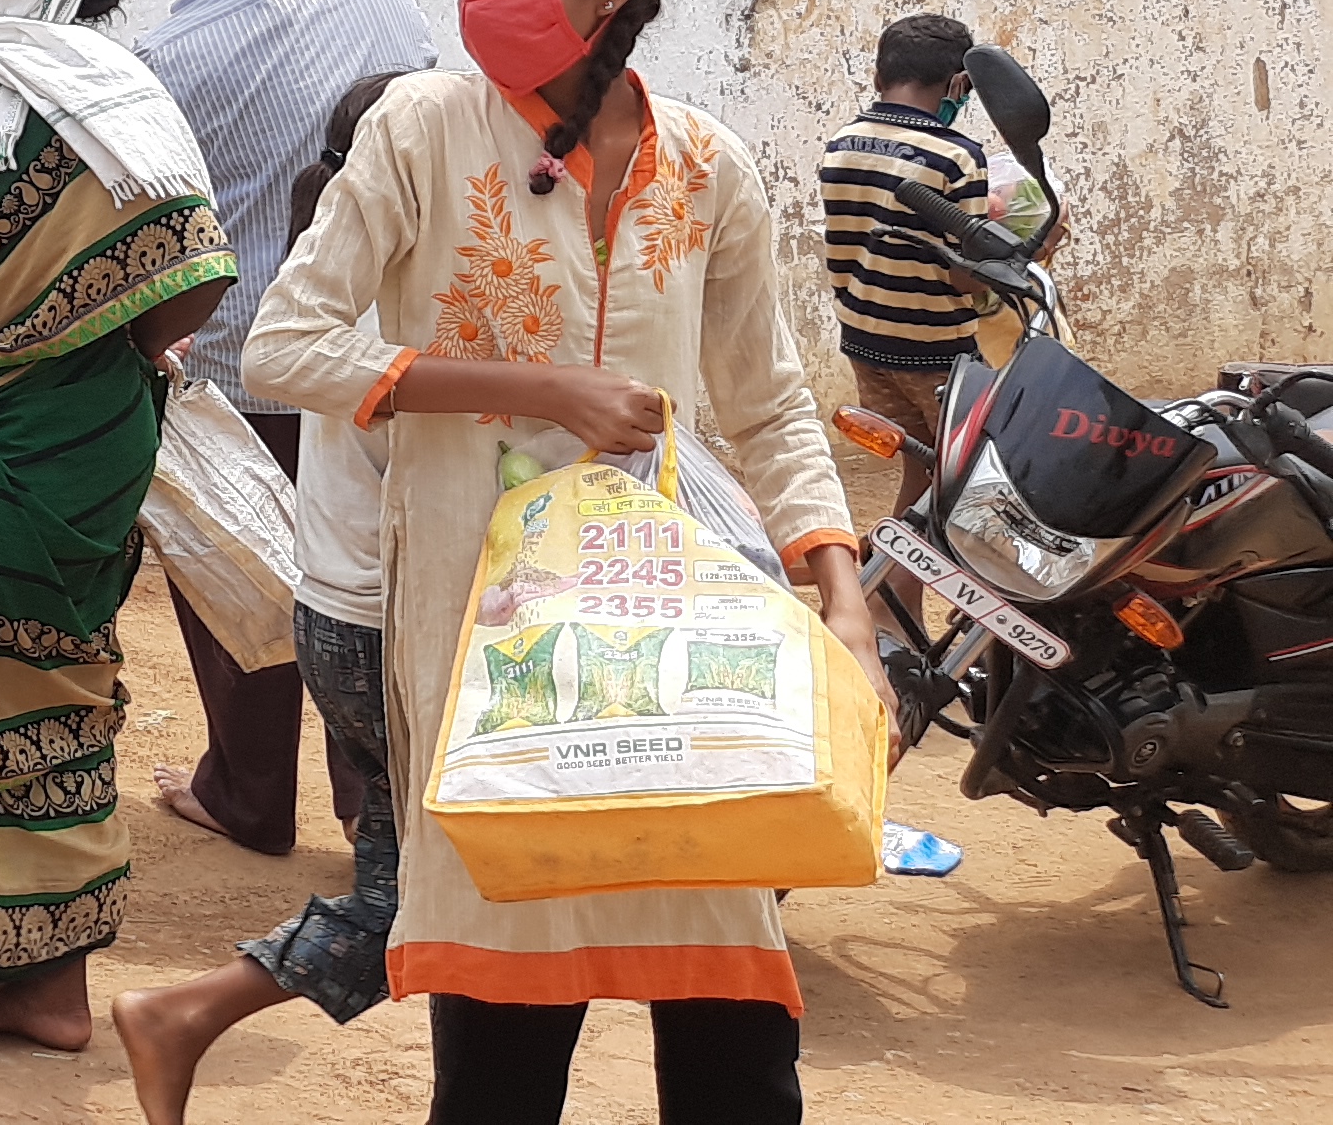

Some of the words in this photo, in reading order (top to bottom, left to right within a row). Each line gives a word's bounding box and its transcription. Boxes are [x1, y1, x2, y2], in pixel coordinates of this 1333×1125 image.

[1049, 408, 1176, 458] Divya
[580, 520, 681, 551] 2111
[580, 558, 684, 587] 2245
[579, 595, 683, 618] 2355
[957, 582, 984, 605] W
[1008, 624, 1057, 661] 9279
[556, 742, 607, 759] VNR
[616, 737, 683, 754] SEED
[556, 762, 584, 770] GOOD
[615, 755, 652, 765] BETTER
[654, 754, 683, 763] YIELD
